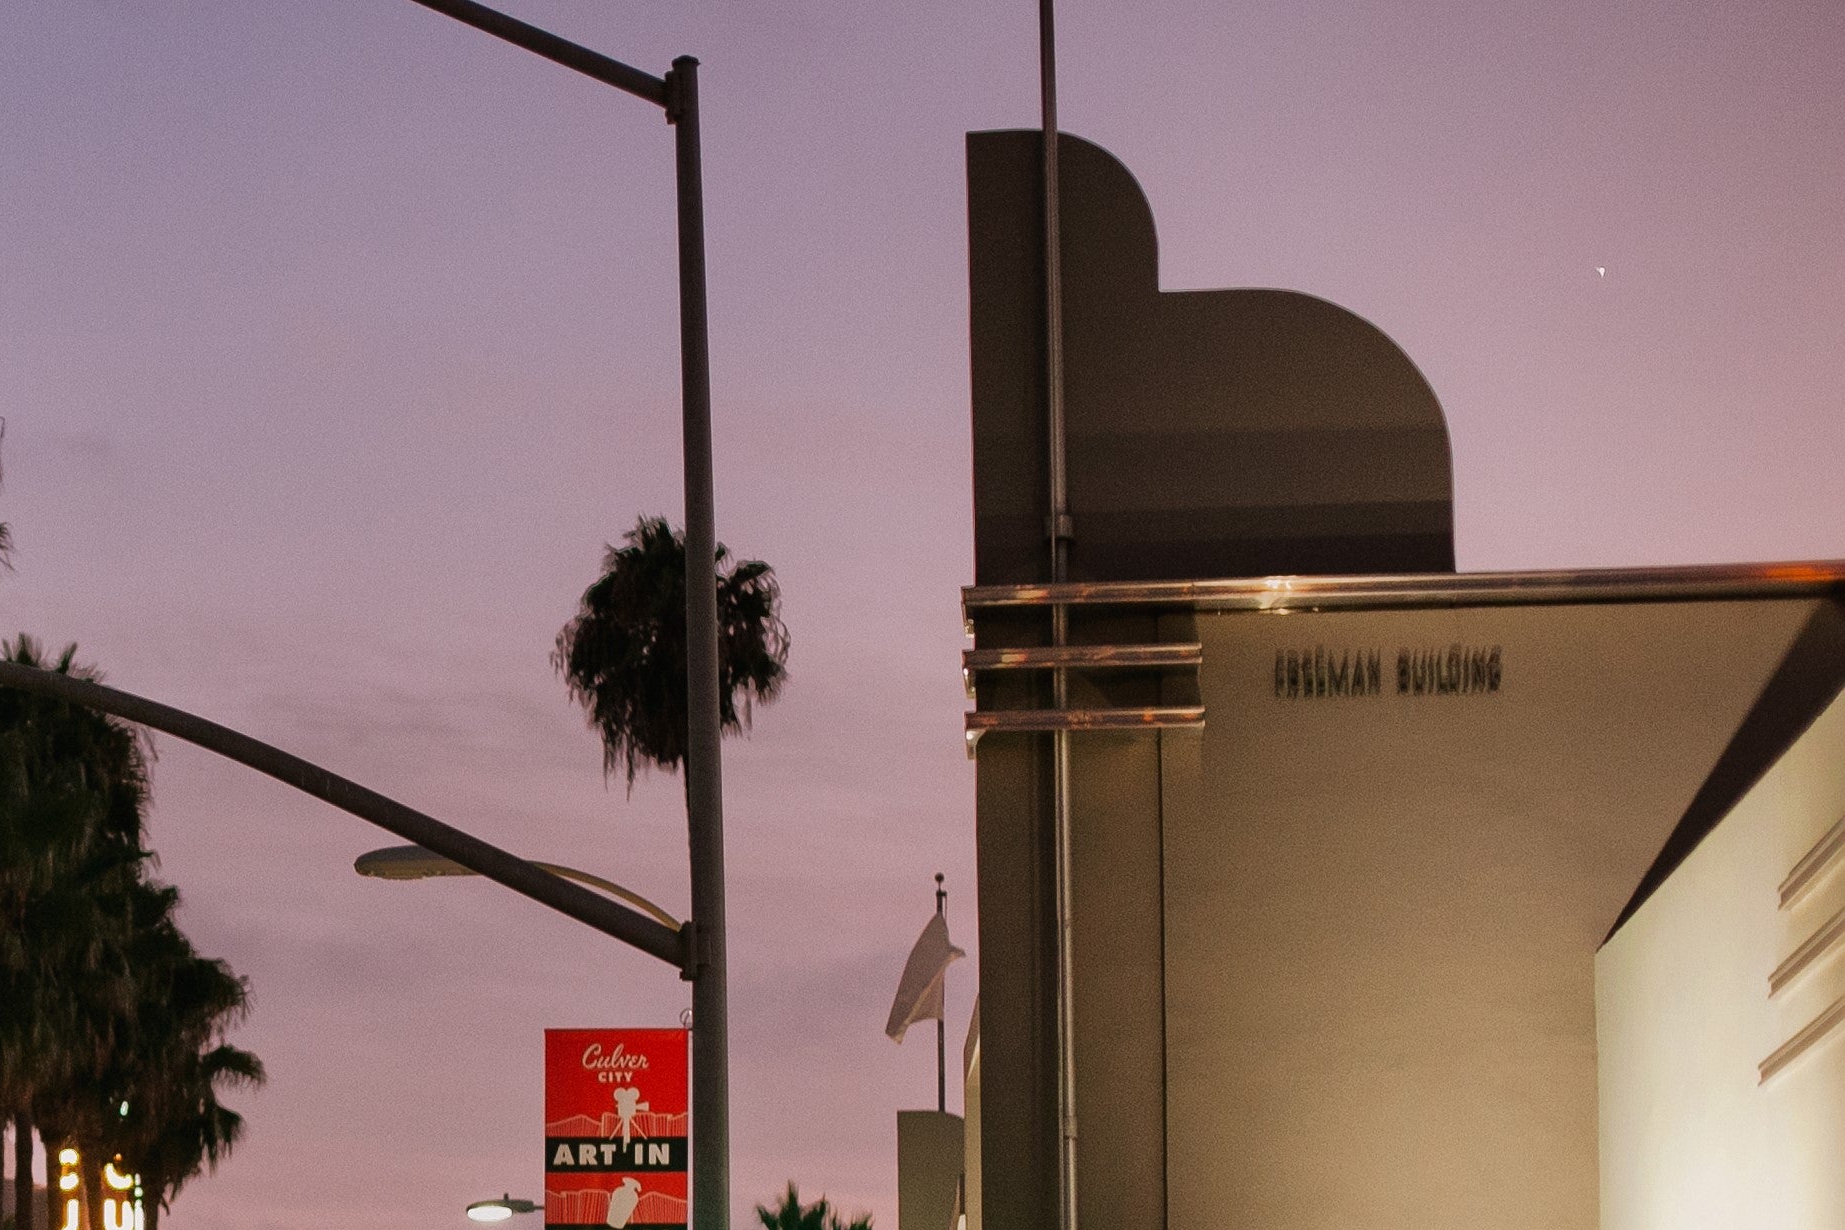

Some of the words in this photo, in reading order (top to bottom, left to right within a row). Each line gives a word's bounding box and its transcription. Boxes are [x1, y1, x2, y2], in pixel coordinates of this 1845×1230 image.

[1396, 645, 1503, 696] BUILDING
[582, 1043, 649, 1069] Culver
[598, 1071, 633, 1083] CITY
[553, 1143, 616, 1165] ART
[635, 1143, 670, 1165] IN
